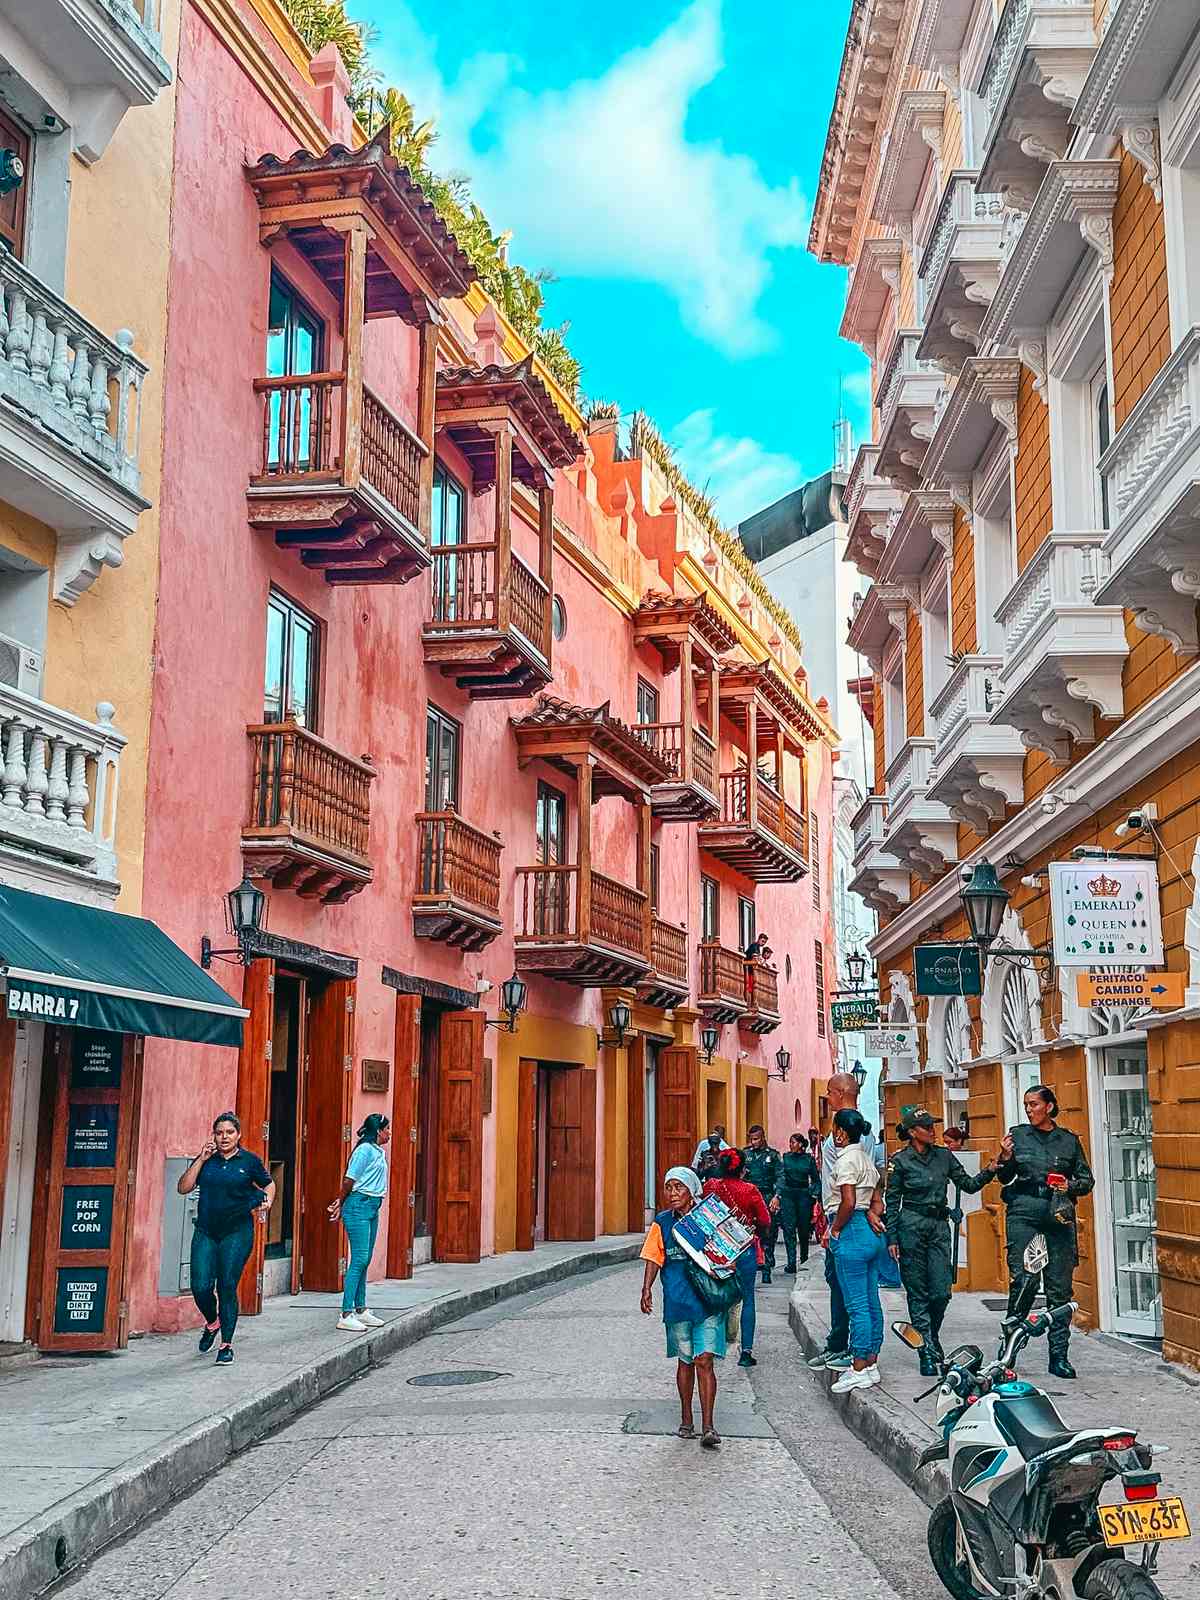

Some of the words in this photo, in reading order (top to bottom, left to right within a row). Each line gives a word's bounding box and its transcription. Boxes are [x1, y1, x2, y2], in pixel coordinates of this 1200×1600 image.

[1074, 900, 1136, 911] EMERALD
[1081, 920, 1128, 930] QUEEN
[1089, 973, 1149, 983] PERITACOL
[1095, 985, 1144, 995] CAMBIO
[8, 989, 66, 1017] BARRA
[69, 998, 79, 1019] 7
[1091, 997, 1151, 1007] EXCHANGE
[76, 1200, 100, 1209] FREE
[76, 1212, 98, 1220] POP
[71, 1223, 101, 1233] CORN
[68, 1283, 97, 1291] LIVING
[73, 1292, 90, 1300] THE
[68, 1301, 93, 1310] DIRTY
[71, 1311, 89, 1319] LIFE
[1105, 1510, 1143, 1536] SYN
[1150, 1504, 1181, 1530] 63F
